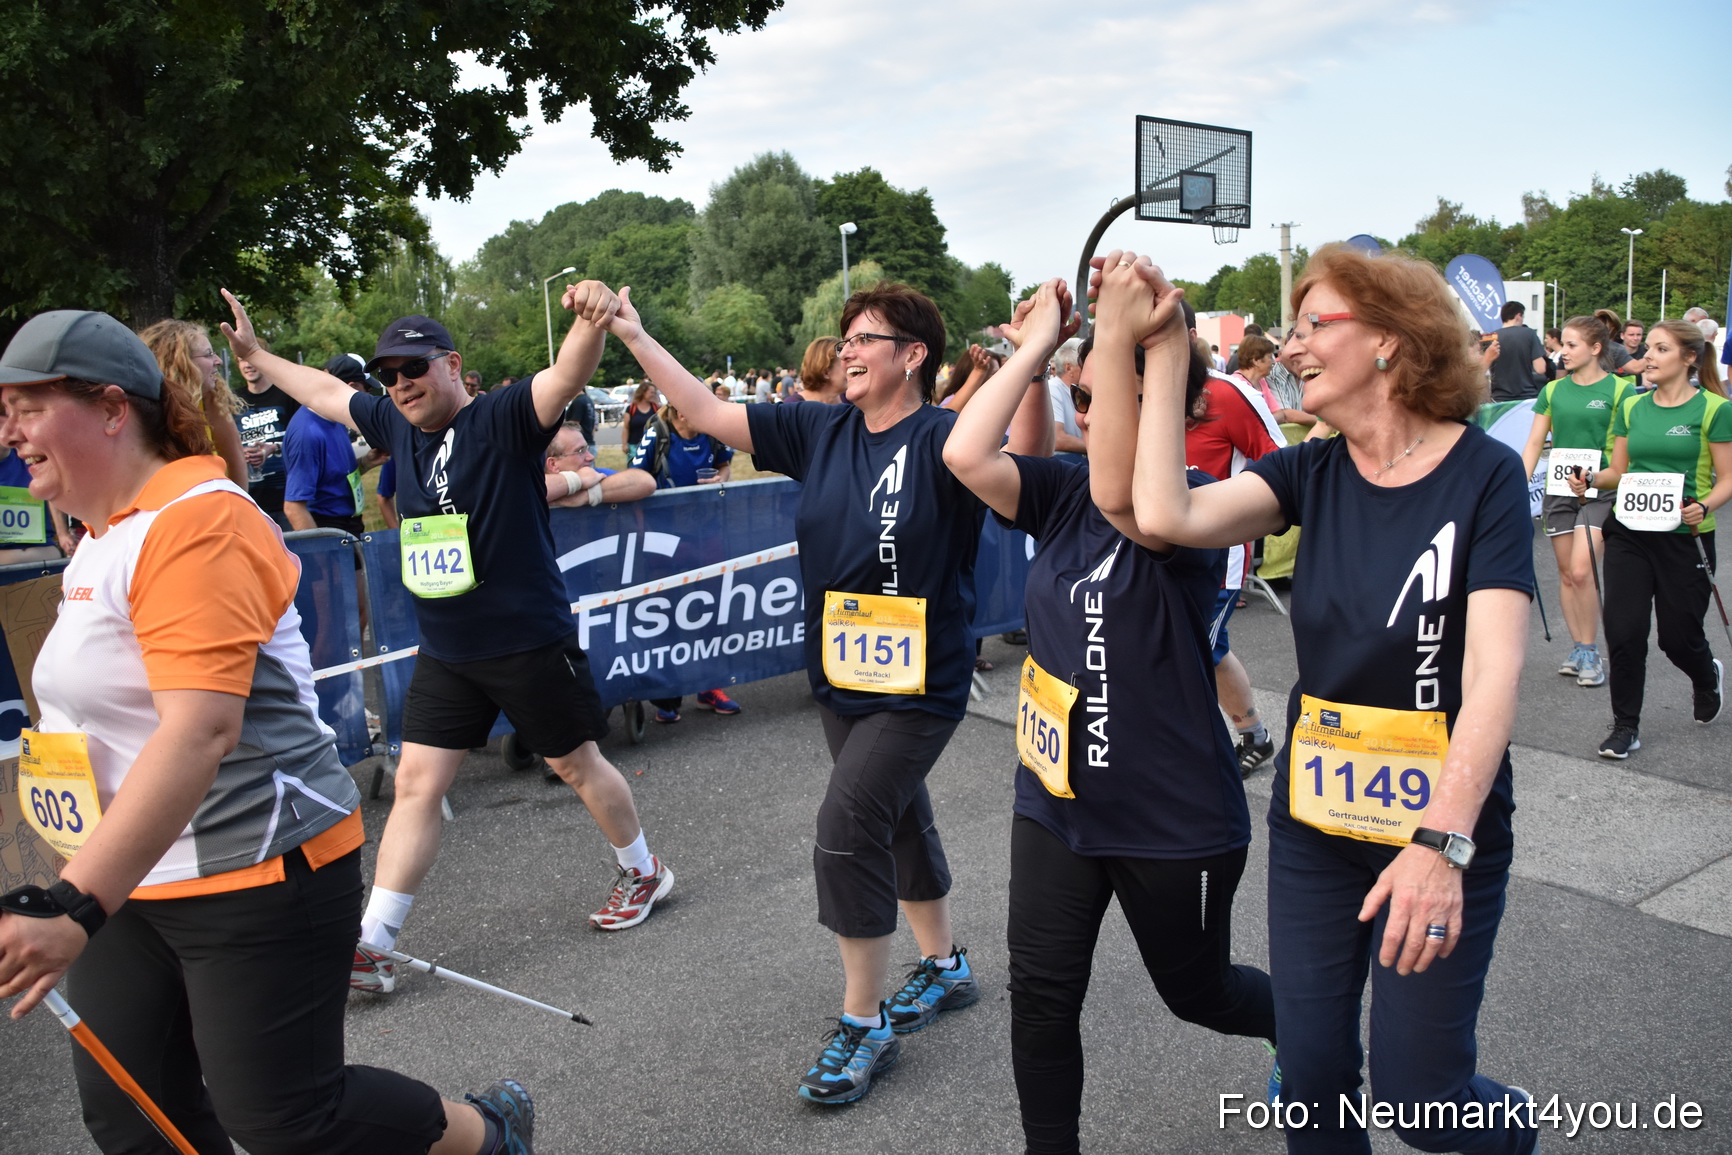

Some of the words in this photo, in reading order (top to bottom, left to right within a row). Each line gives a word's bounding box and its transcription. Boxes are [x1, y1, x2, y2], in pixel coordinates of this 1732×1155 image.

[241, 409, 279, 430] Sunset
[1665, 425, 1692, 436] AOK
[1624, 493, 1674, 512] 8905
[408, 548, 464, 576] 1142
[578, 571, 804, 650] Fische
[833, 632, 911, 667] 1151
[1416, 615, 1445, 710] ONE
[1085, 592, 1109, 767] RAIL.ONE
[1021, 702, 1060, 764] 1150
[1297, 735, 1336, 751] walken
[1310, 722, 1361, 740] firmenlauf
[1305, 755, 1431, 811] 1149
[31, 786, 83, 833] 603
[1328, 809, 1369, 823] Gertraud
[1371, 815, 1402, 827] Weber
